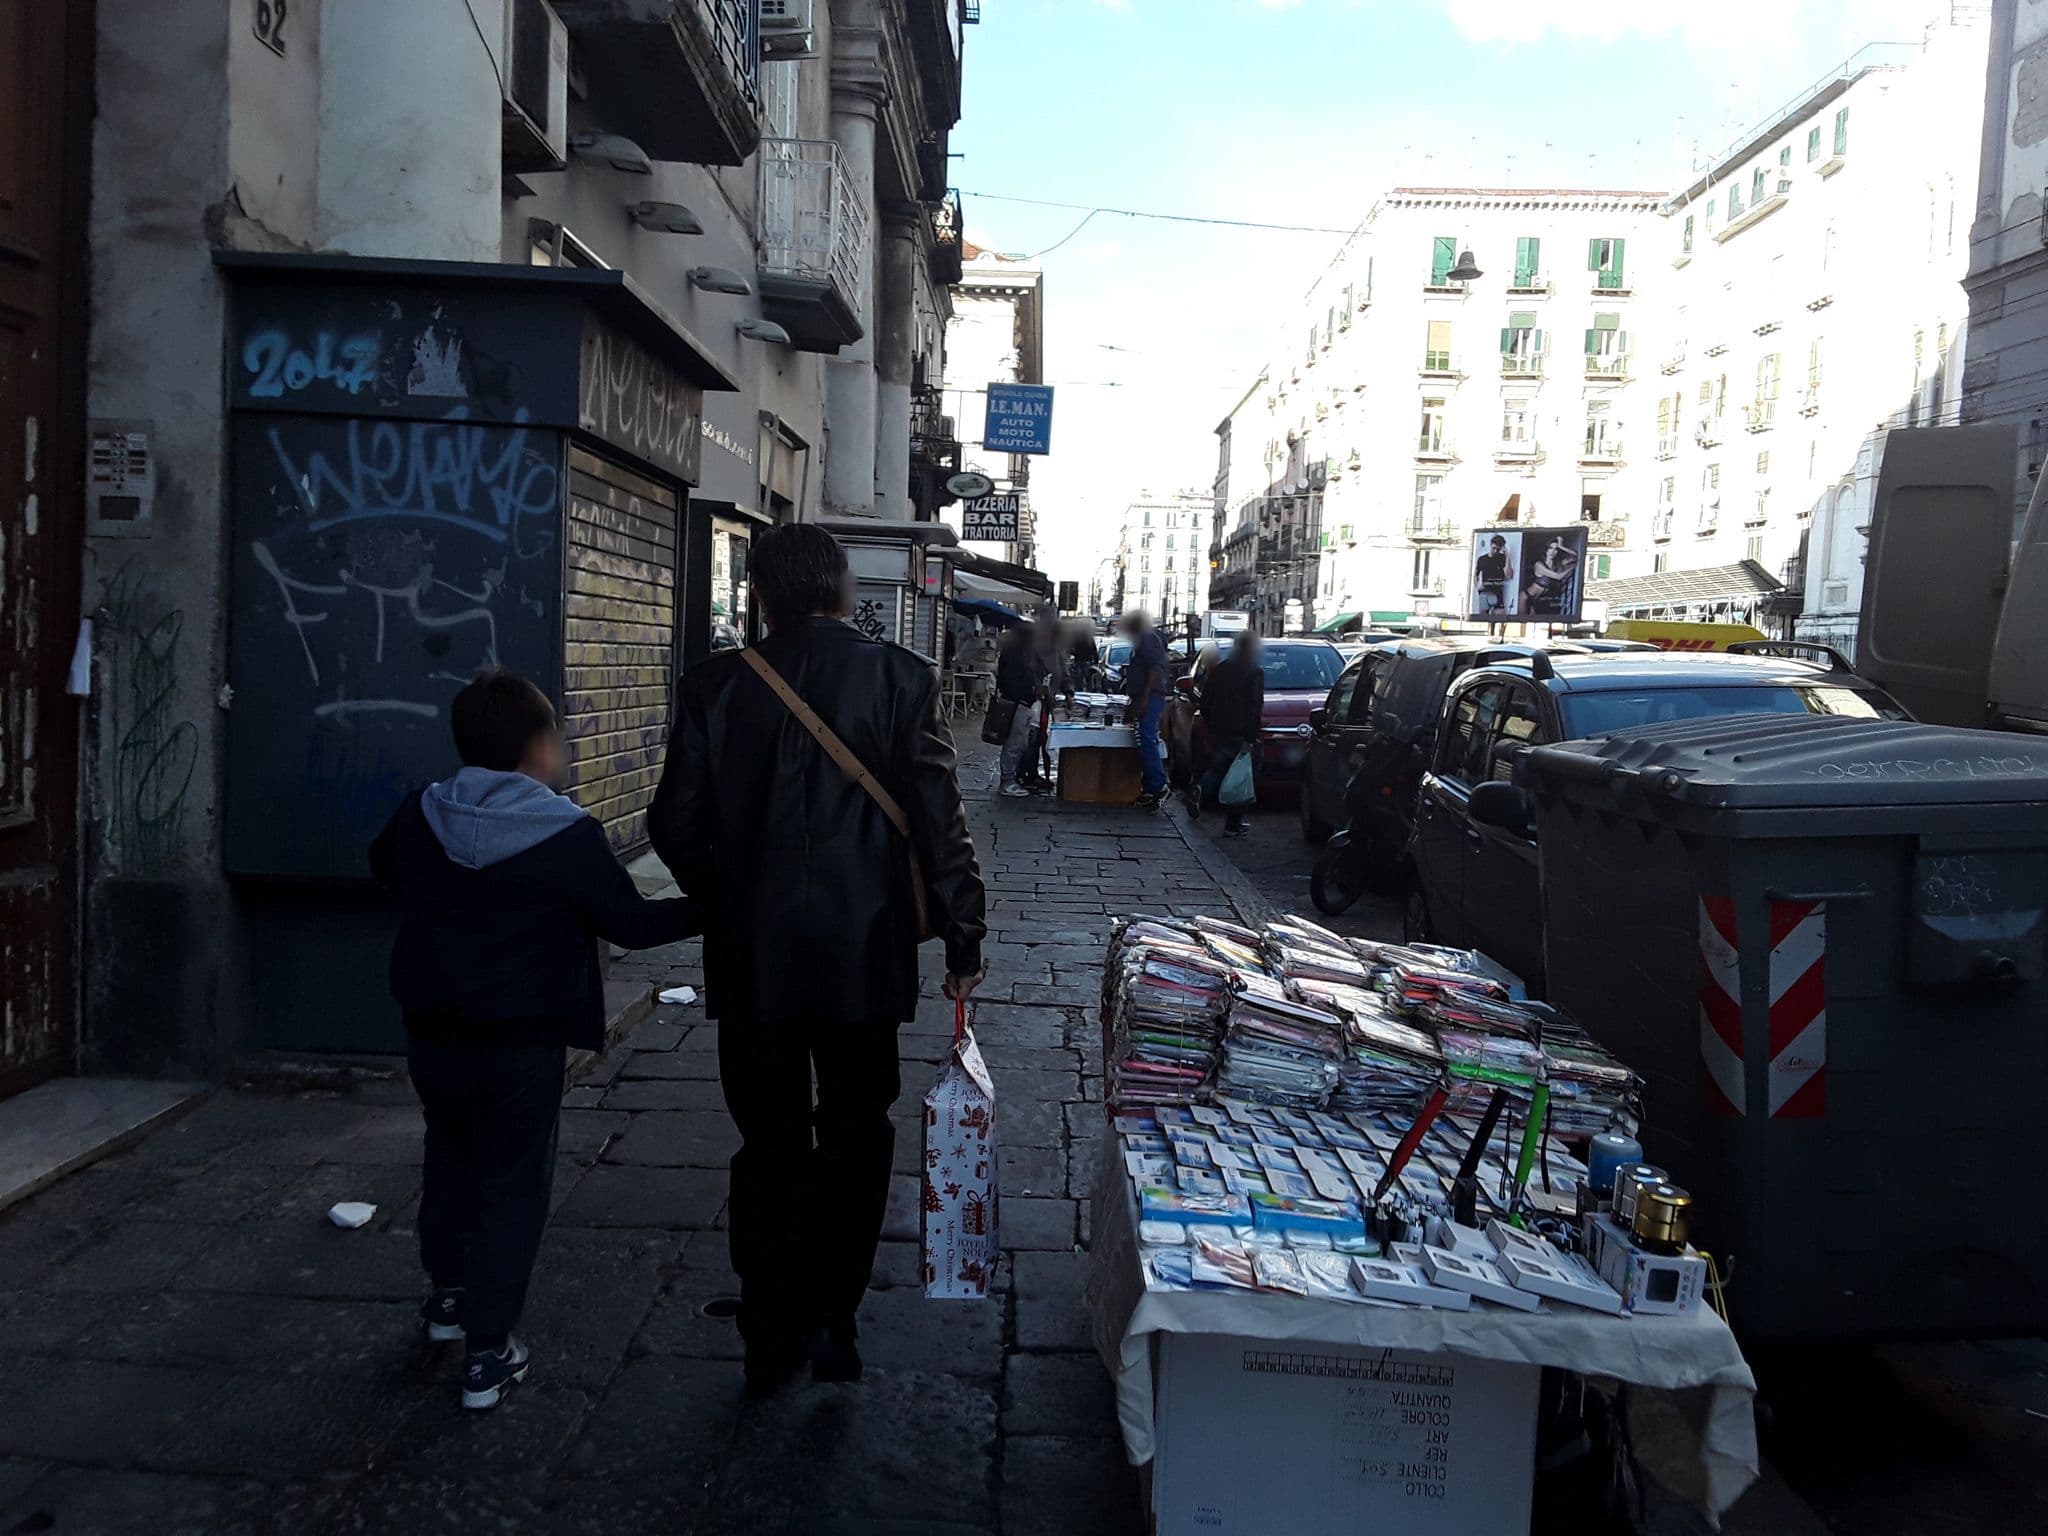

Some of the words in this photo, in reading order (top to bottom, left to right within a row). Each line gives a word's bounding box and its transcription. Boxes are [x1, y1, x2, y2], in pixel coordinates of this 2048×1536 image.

[1000, 418, 1034, 427] AUTO
[998, 428, 1034, 438] MOTO
[988, 437, 1043, 448] NAUTICA
[964, 496, 1017, 512] PIZZERIA
[964, 513, 1016, 525] BAR
[964, 526, 1016, 540] TRATTORIA
[947, 1098, 958, 1138] Christmas
[946, 1218, 956, 1246] Merry
[946, 1249, 956, 1293] Christmas
[1400, 1410, 1450, 1427] COLORE
[1425, 1429, 1450, 1445] ART
[1424, 1447, 1449, 1462] REF
[1397, 1462, 1447, 1480] CLIENTE
[1404, 1482, 1446, 1498] COLLO
